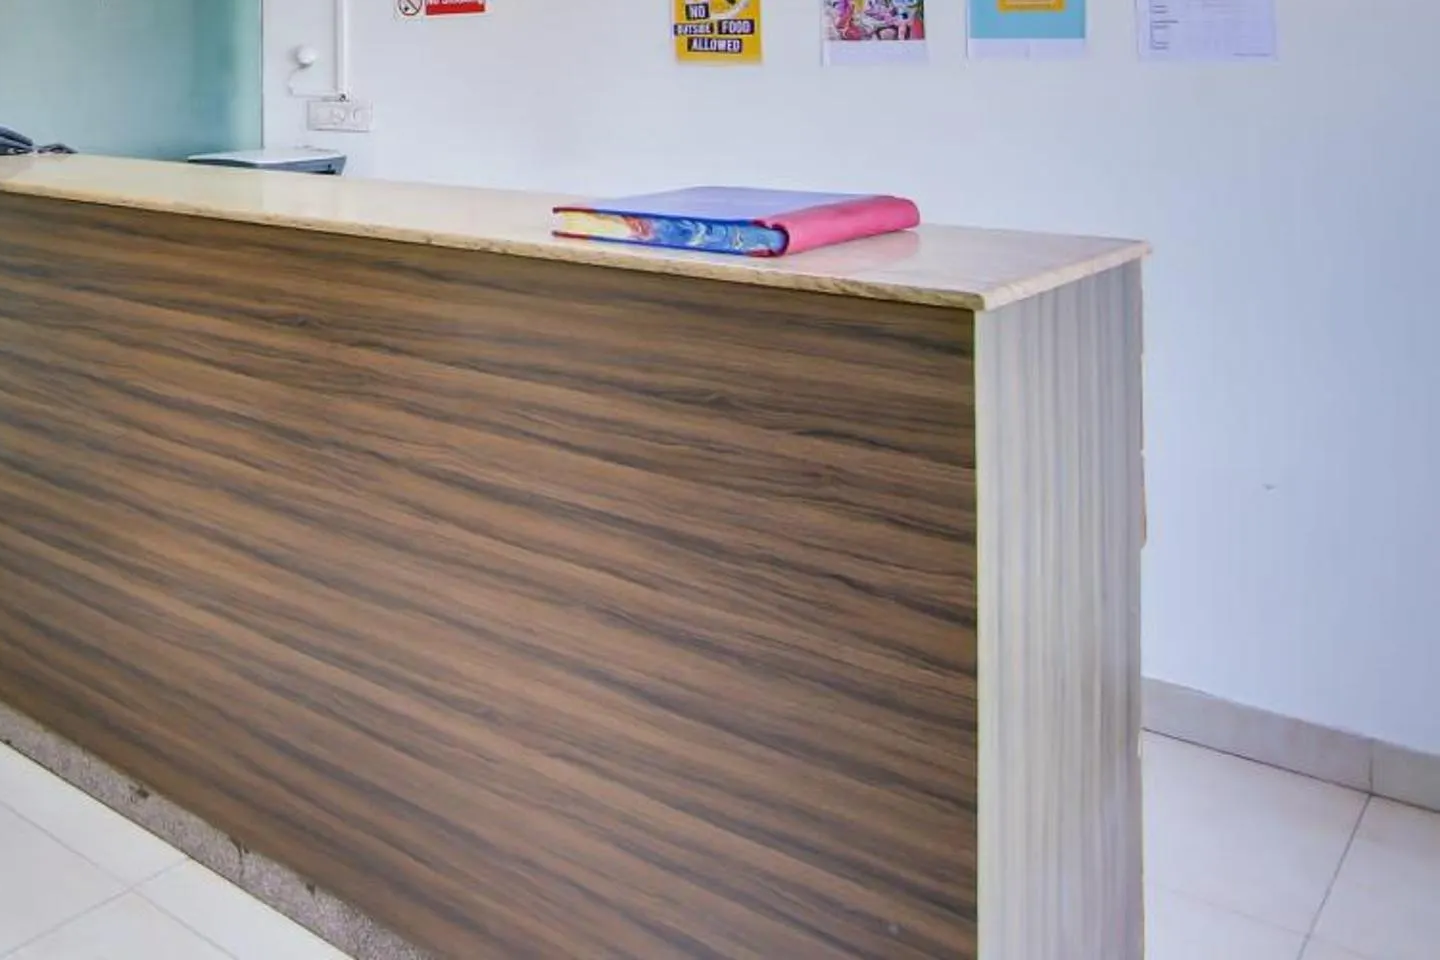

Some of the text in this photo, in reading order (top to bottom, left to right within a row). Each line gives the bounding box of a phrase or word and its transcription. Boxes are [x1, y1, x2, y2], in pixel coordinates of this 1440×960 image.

[690, 4, 706, 18] NO
[721, 20, 751, 34] FOOD
[691, 37, 740, 52] ALLOWED
